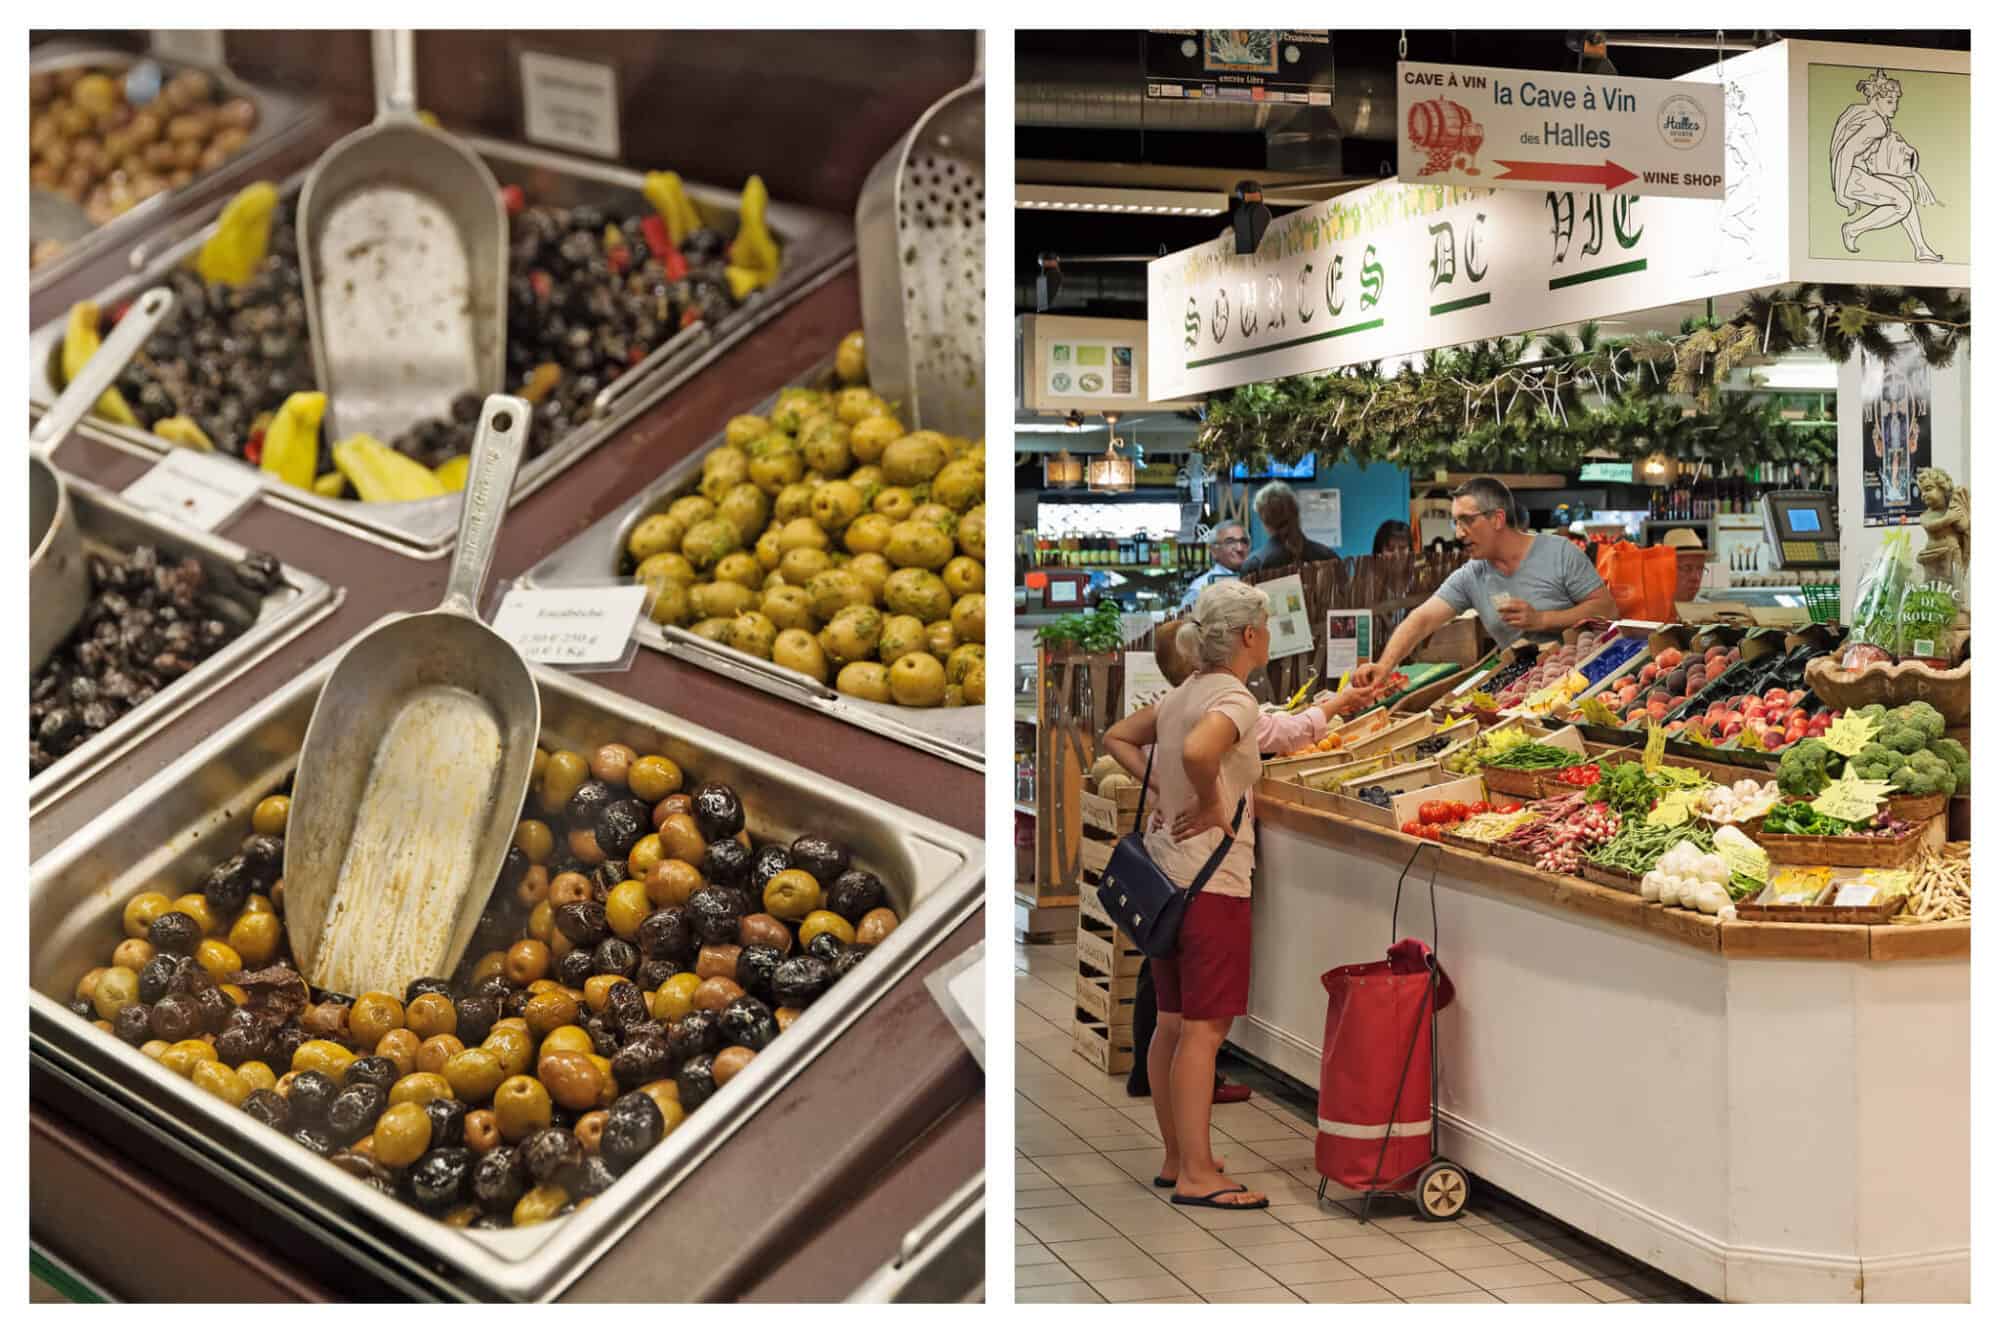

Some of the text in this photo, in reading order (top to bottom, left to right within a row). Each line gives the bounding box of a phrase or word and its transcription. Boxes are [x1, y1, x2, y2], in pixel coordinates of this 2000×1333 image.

[1404, 71, 1487, 89] CAVE À VIN
[1494, 79, 1512, 105] la
[1520, 82, 1576, 110] Cave
[1583, 84, 1597, 111] à
[1602, 87, 1636, 113] Vin
[1520, 121, 1611, 149] des Halles
[1643, 171, 1722, 187] WINE SHOP
[1184, 190, 1644, 352] SOURCES DE VIE
